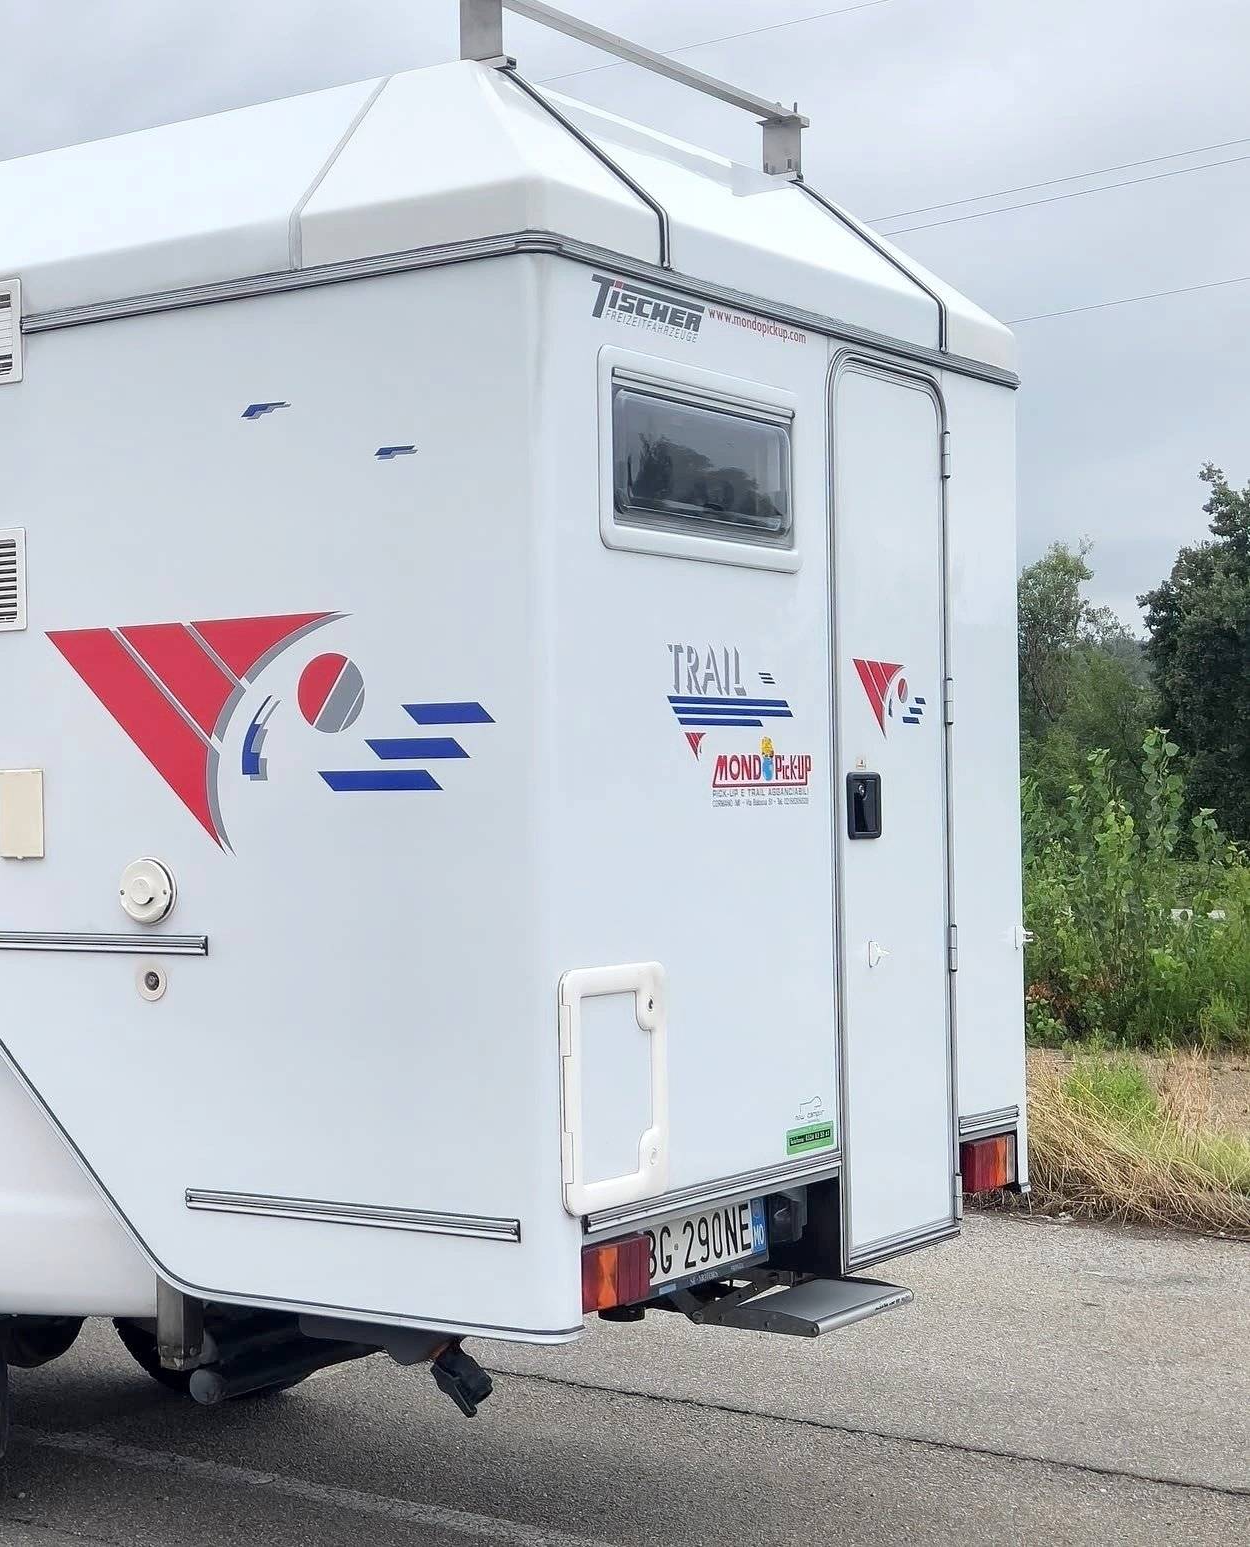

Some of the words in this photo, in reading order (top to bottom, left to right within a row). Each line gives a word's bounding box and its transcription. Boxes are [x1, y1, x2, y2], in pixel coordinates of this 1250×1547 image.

[605, 308, 699, 344] FREIZEITFAHRZEUGE
[708, 306, 807, 345] www.mondopickup.com
[667, 642, 748, 697] TRAIL
[748, 788, 766, 797] TRAIL
[682, 1203, 752, 1270] 290NE
[752, 1222, 765, 1248] MO
